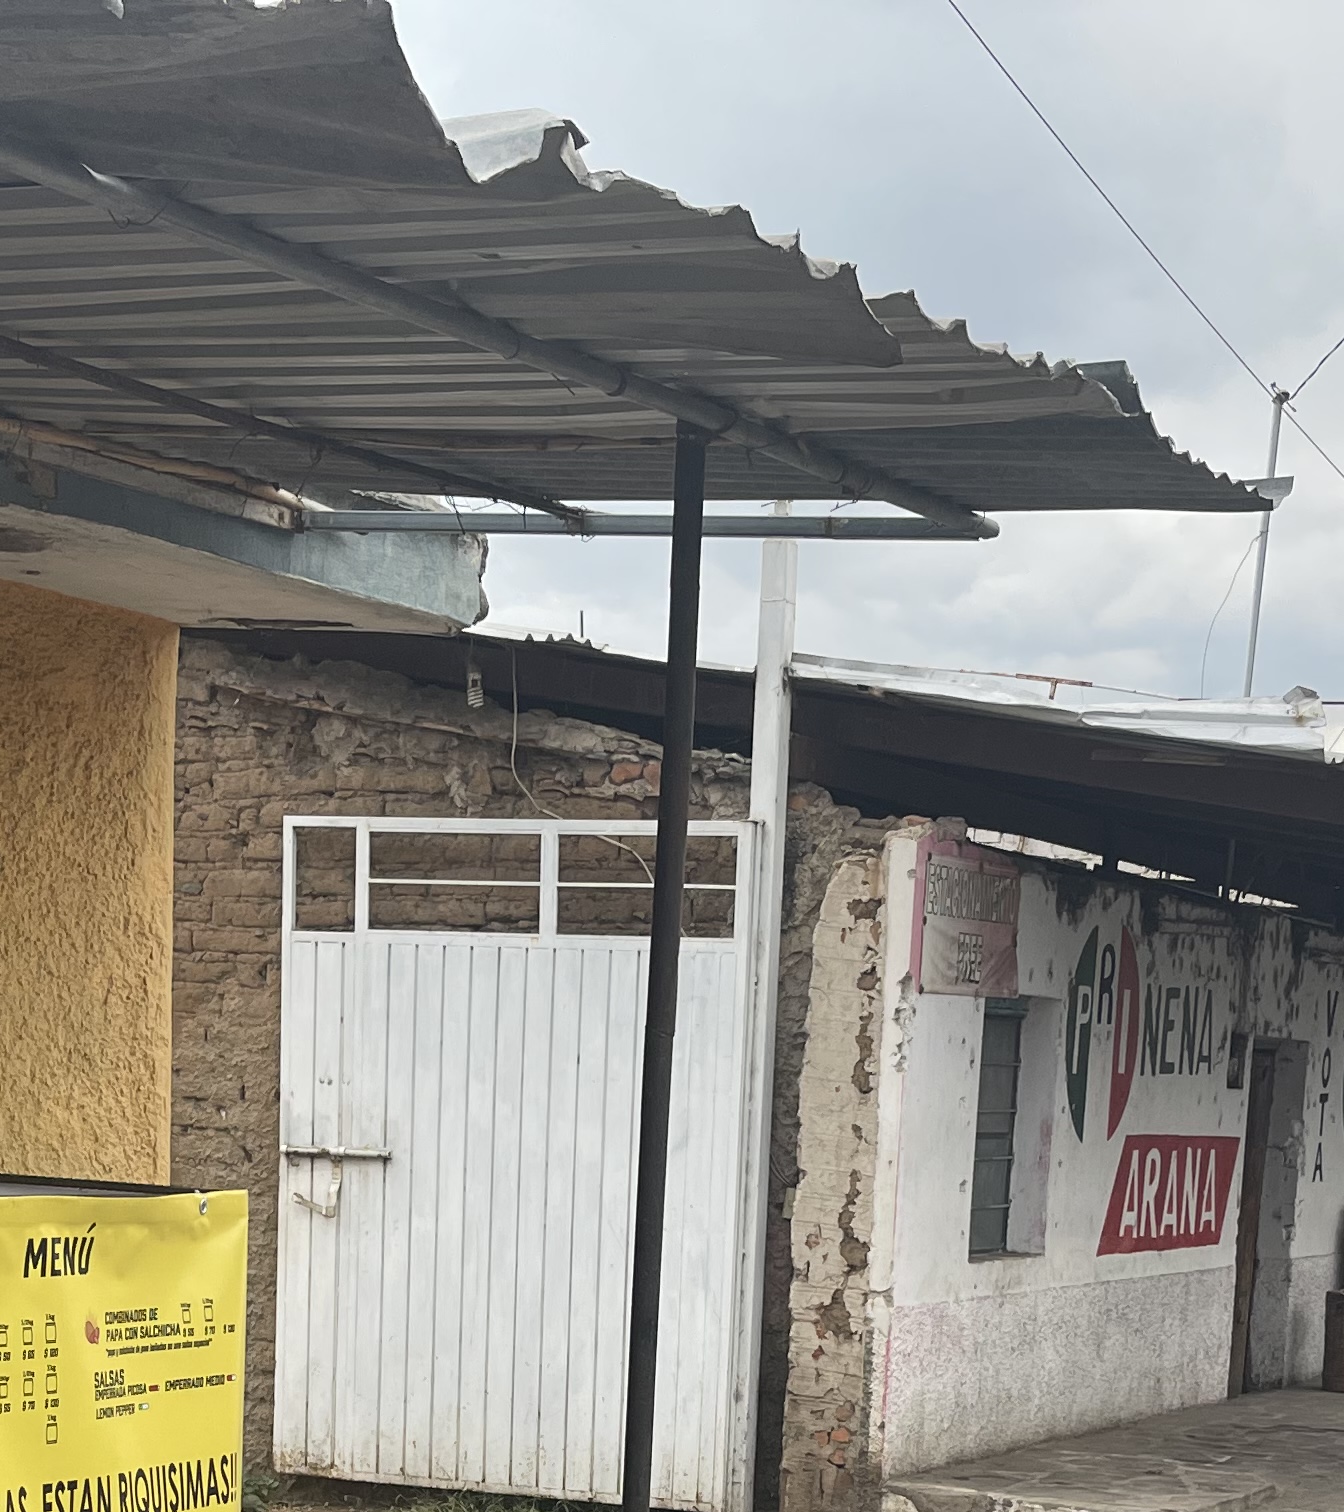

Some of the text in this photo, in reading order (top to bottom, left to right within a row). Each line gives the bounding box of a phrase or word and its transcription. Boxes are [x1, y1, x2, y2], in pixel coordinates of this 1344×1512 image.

[1072, 944, 1212, 1076] PRI NENA
[1312, 990, 1339, 1182] VOTA
[1119, 1147, 1216, 1238] ARANA
[24, 1222, 96, 1278] MENÚ
